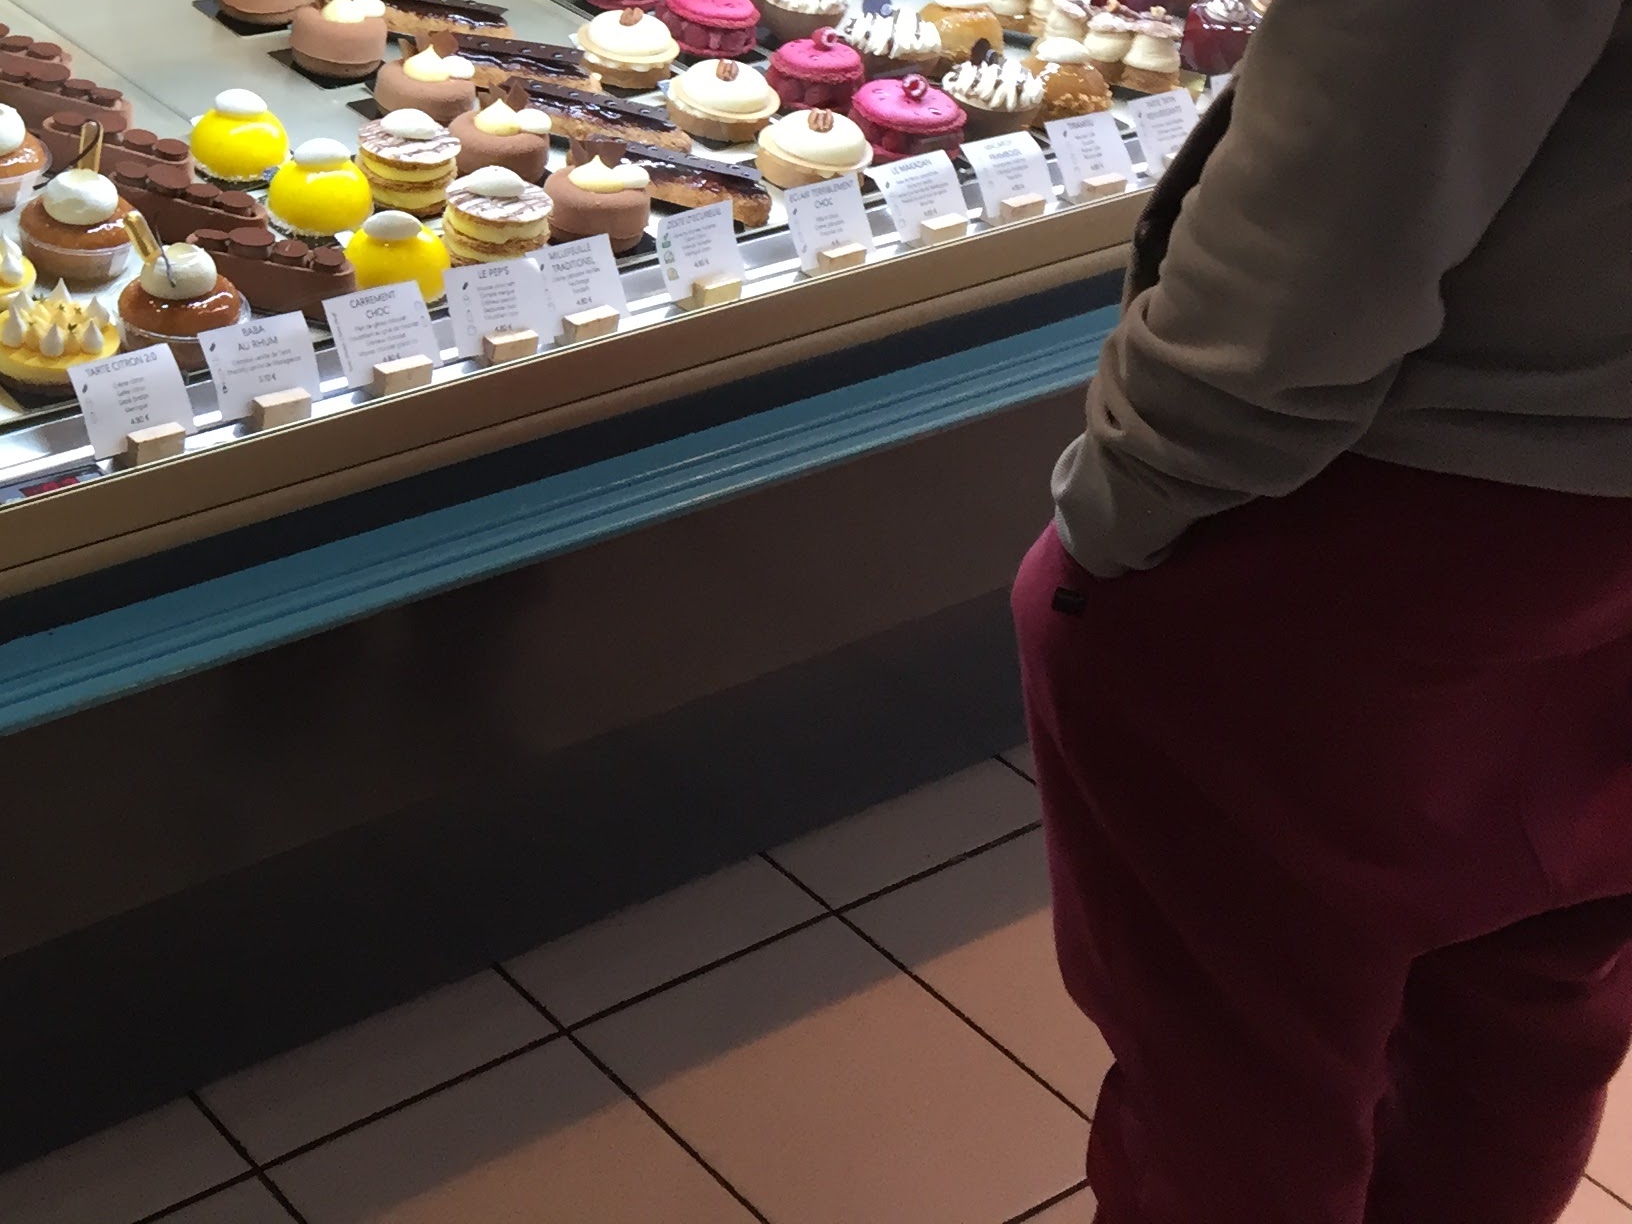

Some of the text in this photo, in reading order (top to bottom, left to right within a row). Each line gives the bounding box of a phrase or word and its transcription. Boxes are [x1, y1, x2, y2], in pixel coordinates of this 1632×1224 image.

[477, 269, 488, 279] LE
[349, 290, 397, 309] CARREMENT
[365, 306, 391, 319] CHOC
[241, 325, 265, 337] BABA
[238, 336, 279, 351] AU RHUM
[84, 363, 111, 377] TARTE
[111, 355, 144, 371] CITRON
